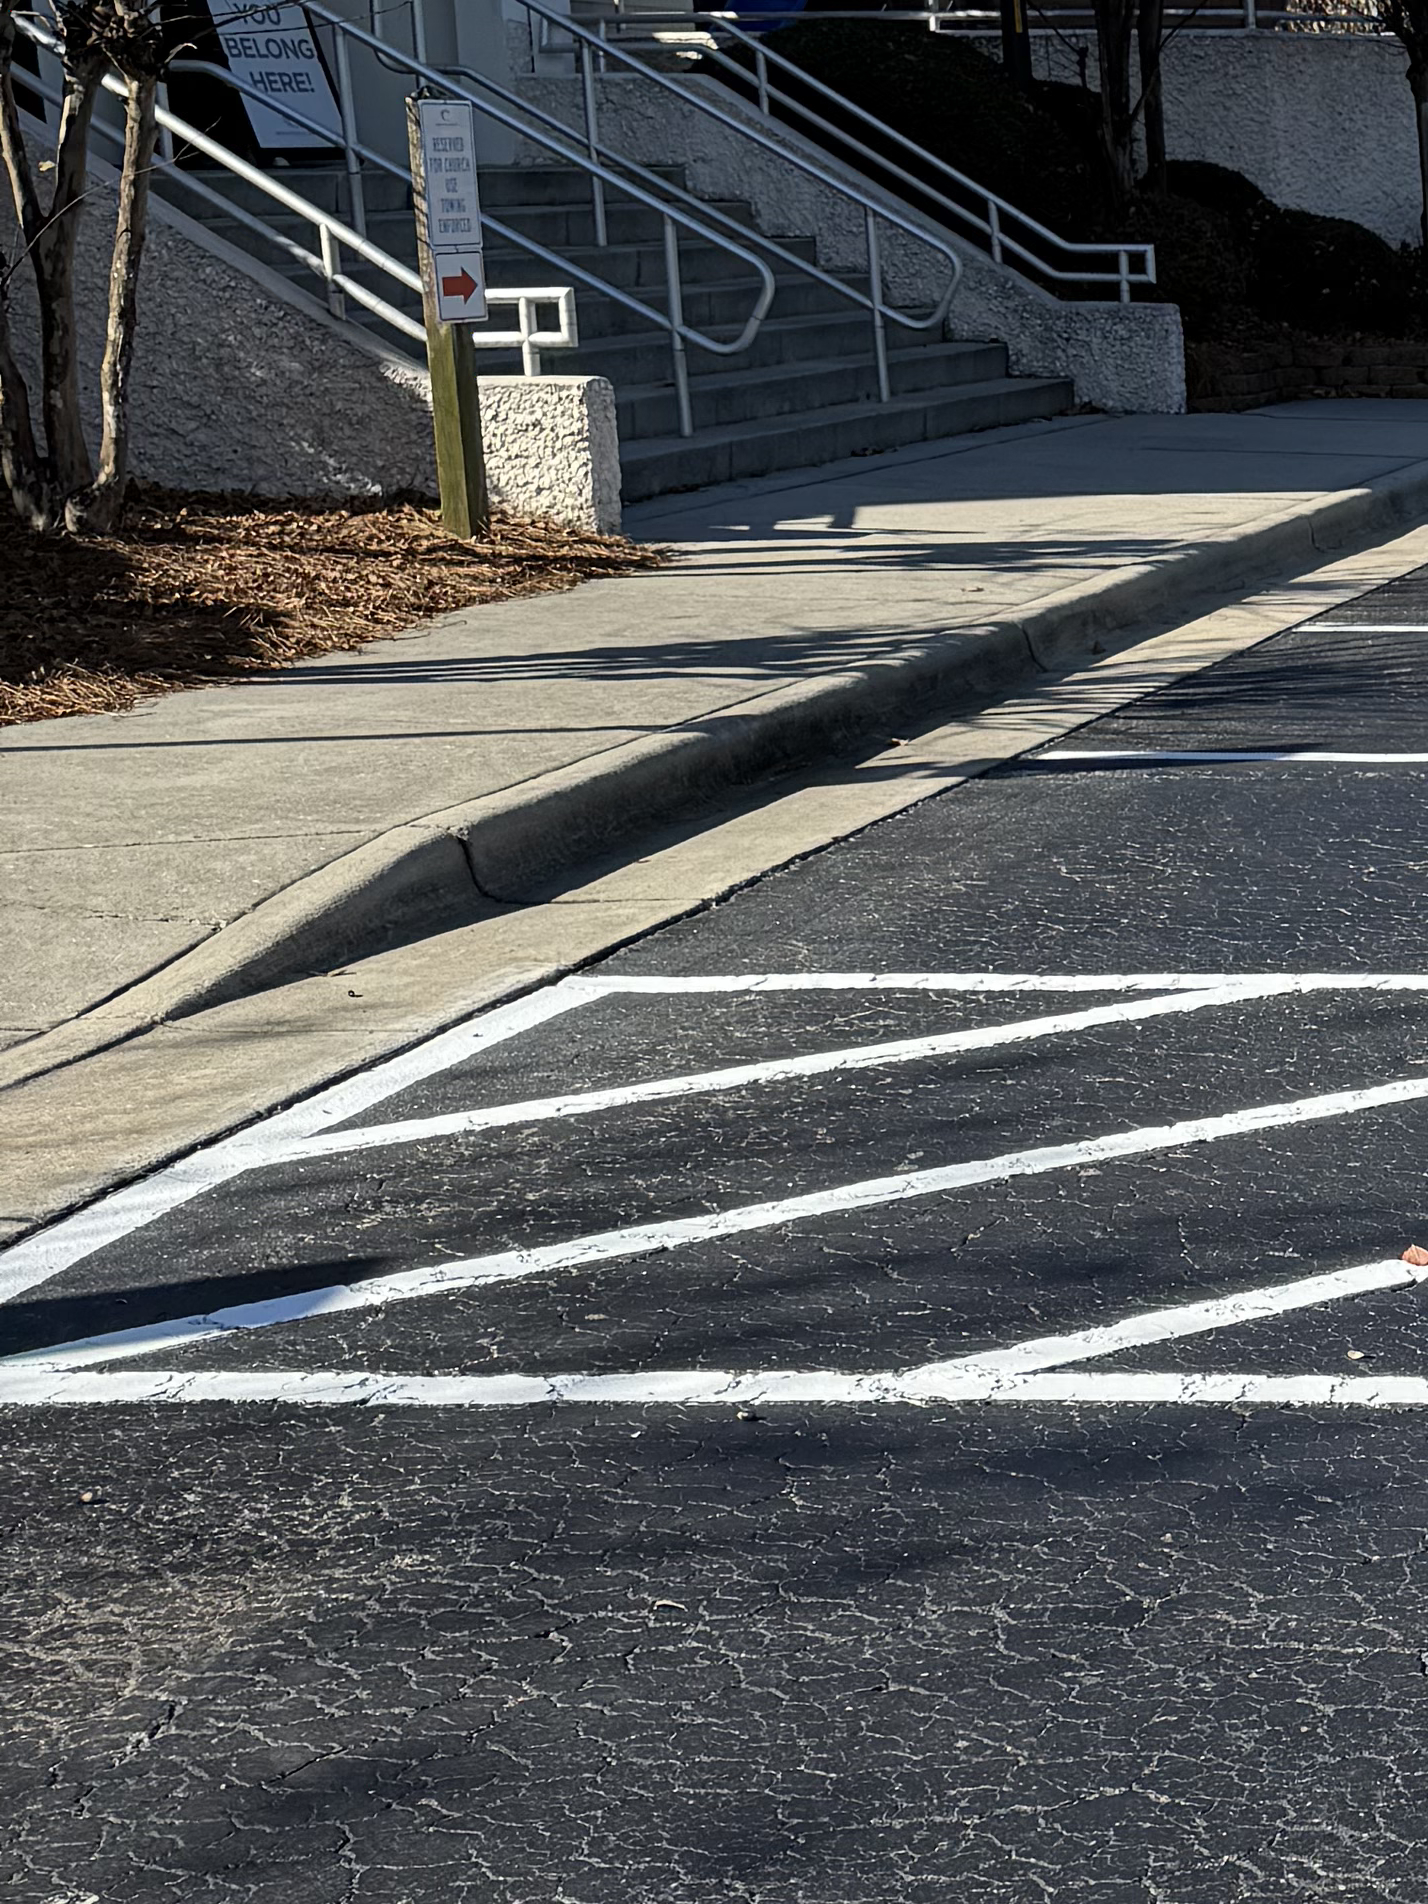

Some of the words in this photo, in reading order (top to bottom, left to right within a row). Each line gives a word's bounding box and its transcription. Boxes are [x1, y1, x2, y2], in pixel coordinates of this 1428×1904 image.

[232, 2, 281, 25] YOU
[224, 37, 315, 60] BELONG
[249, 71, 315, 94] HERE!
[429, 157, 443, 173] FOR
